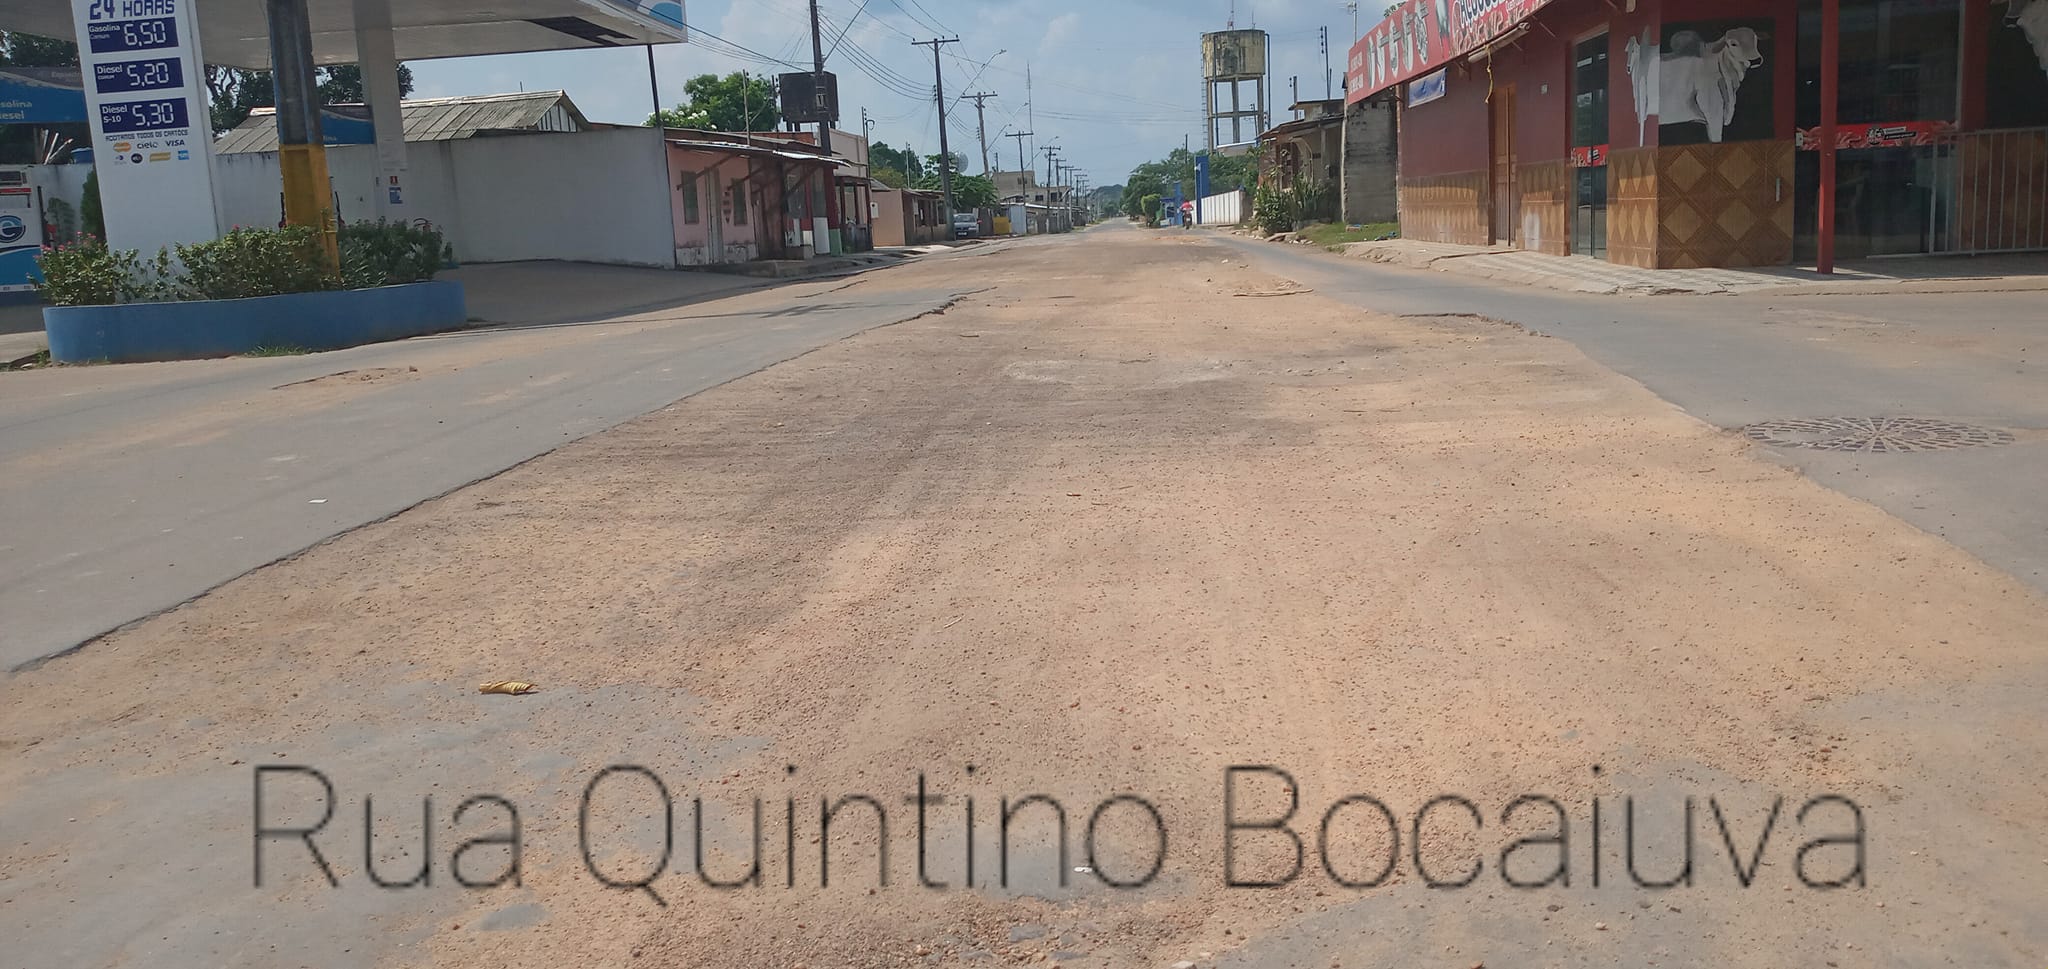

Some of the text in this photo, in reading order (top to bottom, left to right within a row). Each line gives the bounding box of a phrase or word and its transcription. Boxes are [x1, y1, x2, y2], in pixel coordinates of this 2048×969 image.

[89, 0, 115, 20] 24
[88, 20, 167, 47] Gasolina 6,50
[97, 64, 122, 74] Diesel
[126, 62, 169, 87] 5,20
[102, 102, 174, 126] Diesel 5,30
[103, 115, 121, 123] S-10
[166, 139, 185, 147] VISA
